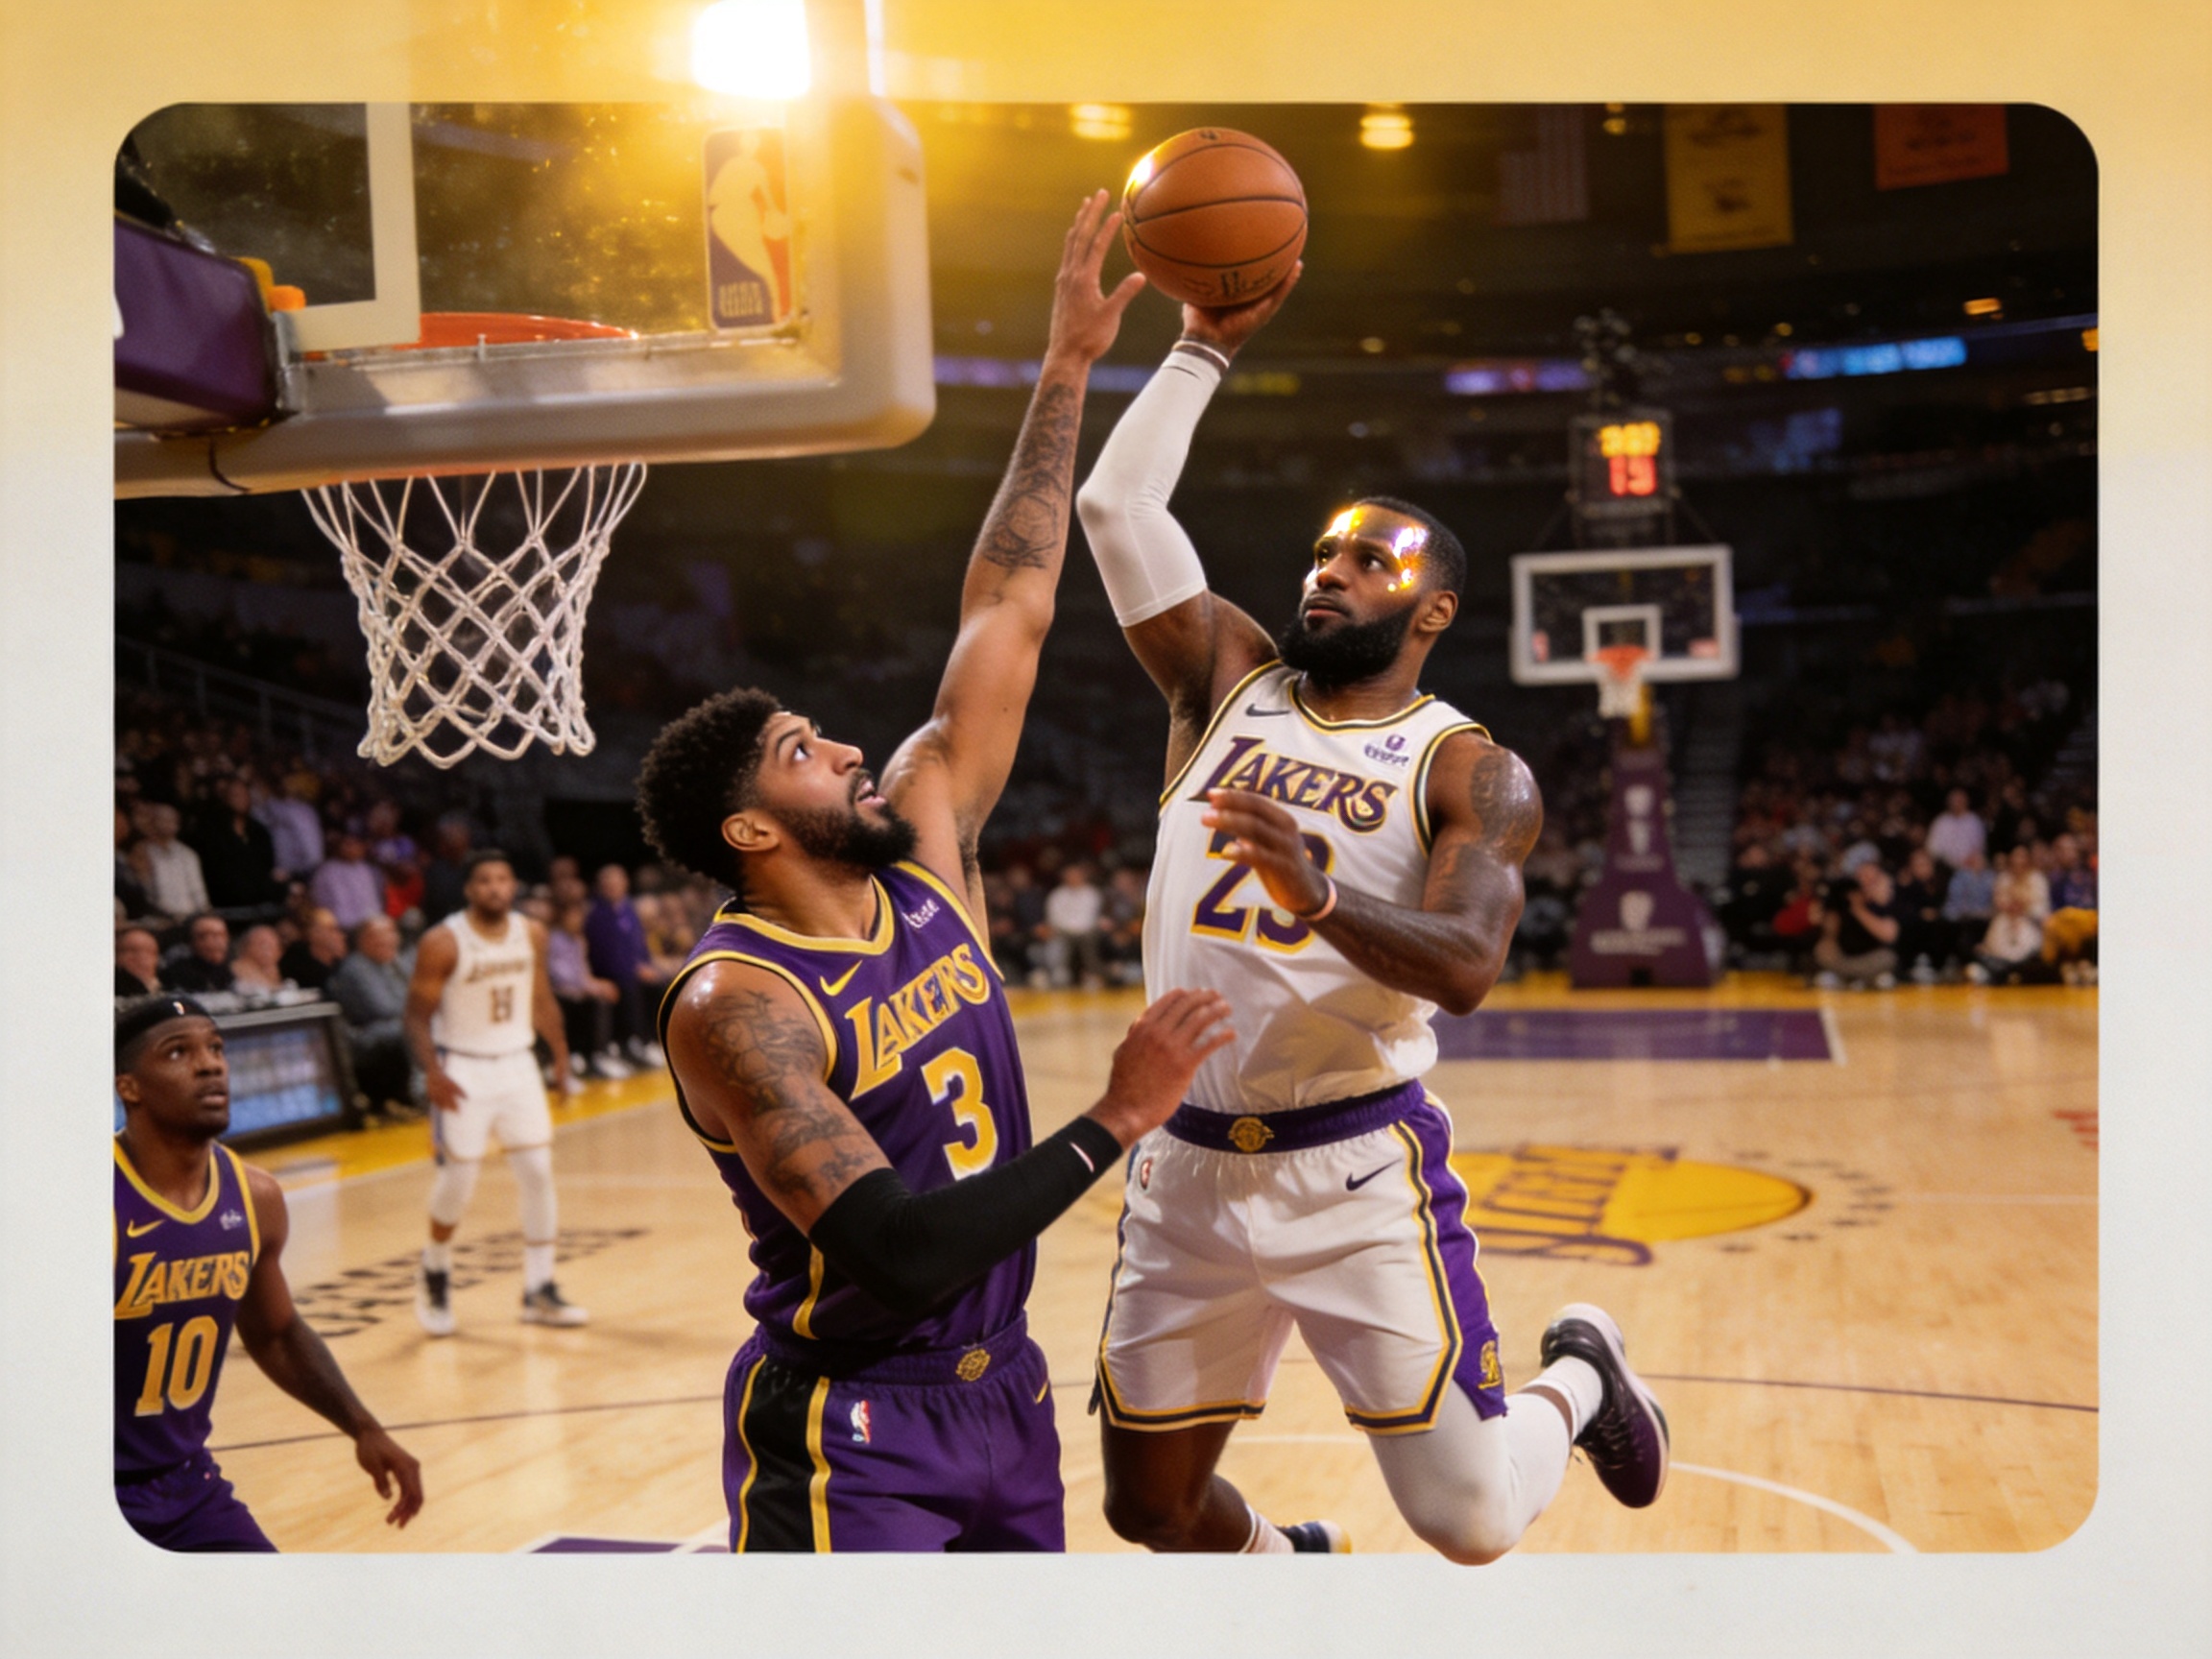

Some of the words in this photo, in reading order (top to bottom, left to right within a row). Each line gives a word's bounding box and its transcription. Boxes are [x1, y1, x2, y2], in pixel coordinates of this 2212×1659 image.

[1188, 734, 1399, 835] LAKERS
[844, 943, 991, 1102] LAKERS
[921, 1046, 998, 1181] 3
[114, 1250, 251, 1320] LAKERS
[134, 1314, 219, 1417] 10
